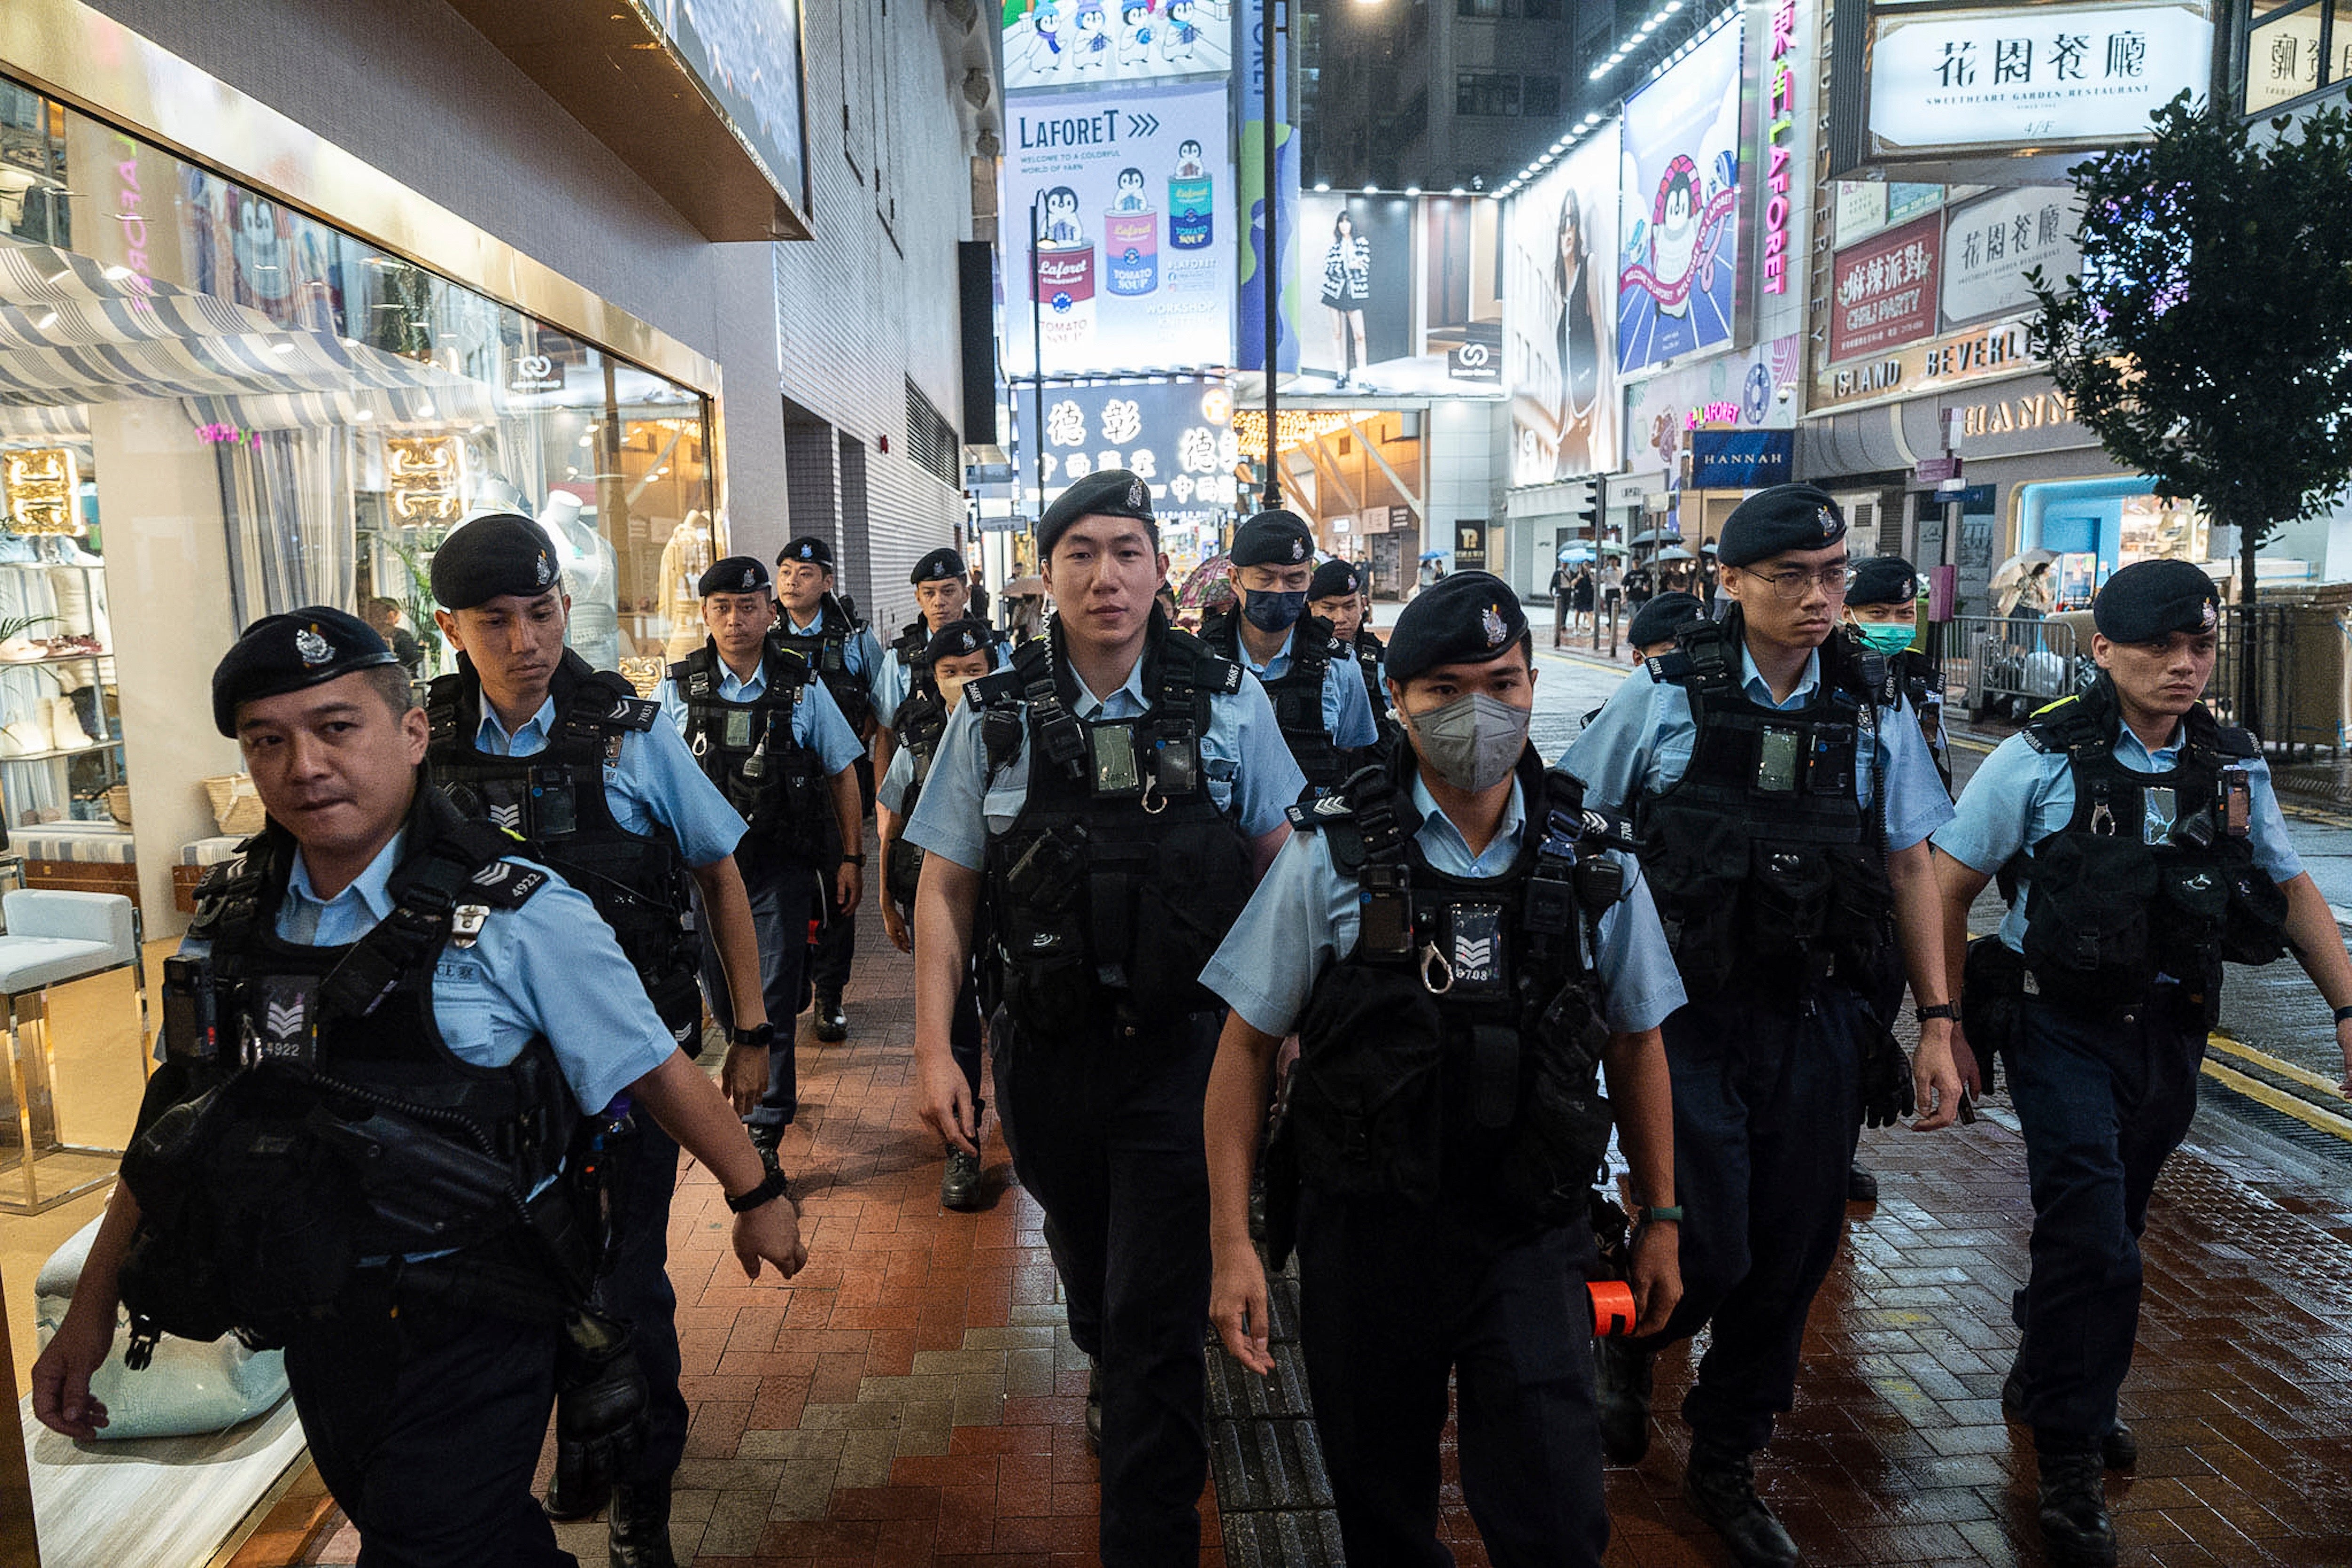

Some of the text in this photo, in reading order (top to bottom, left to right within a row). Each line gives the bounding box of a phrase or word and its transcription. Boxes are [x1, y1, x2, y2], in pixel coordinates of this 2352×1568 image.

[1934, 31, 2146, 88] 花園餐廳
[1926, 85, 2149, 104] SWEETHEART GARDEN RESTAURANT
[1019, 110, 1119, 149] LAFORET
[1962, 205, 2059, 270] 花園餐廳
[1878, 288, 1921, 322] PARTY
[1835, 359, 1901, 398] ISLAND
[1704, 453, 1782, 464] HANNAH
[1225, 664, 1240, 688] 26687
[966, 681, 983, 704] 26687
[636, 704, 655, 723] 7031
[511, 873, 543, 899] 4922
